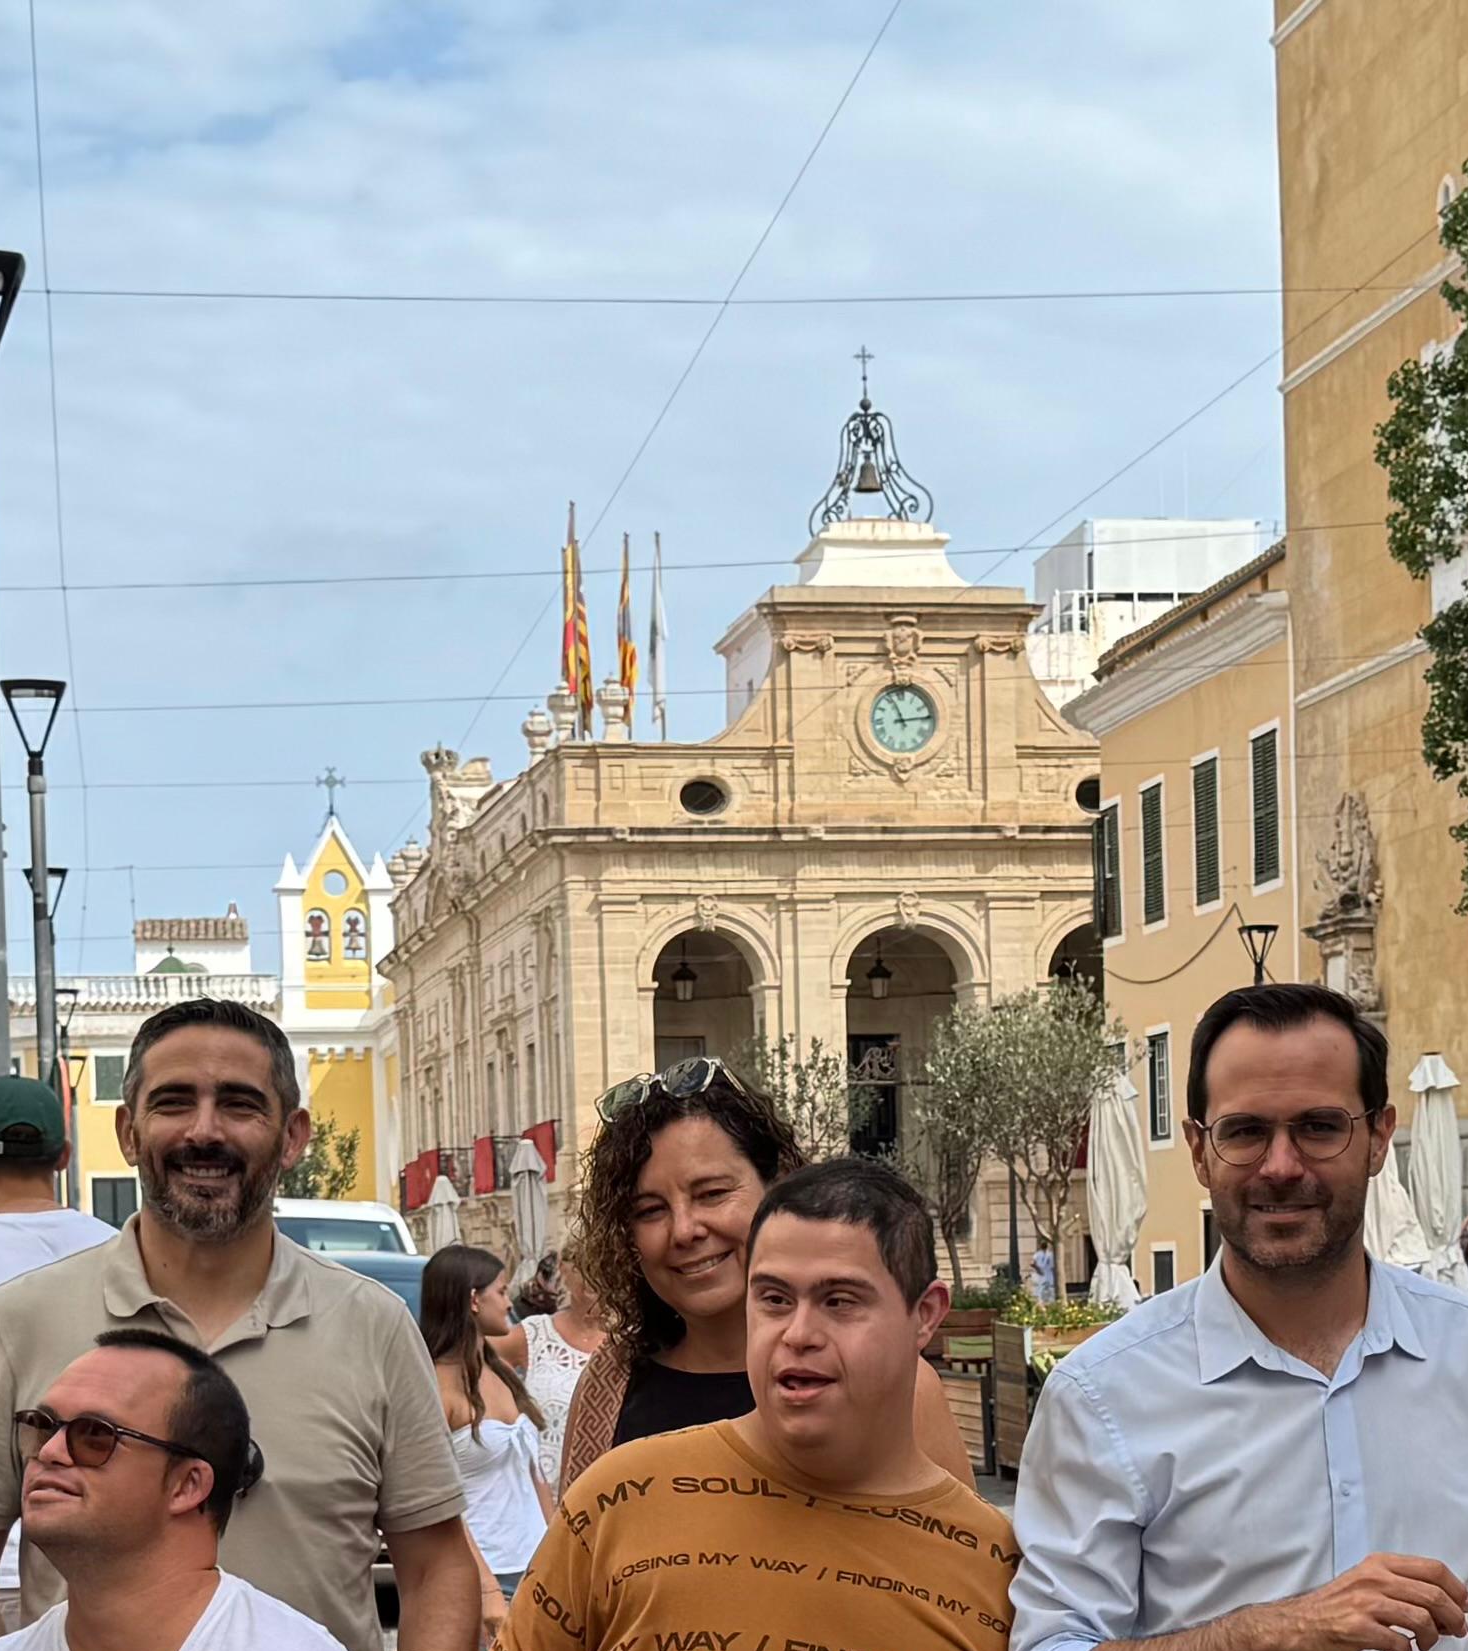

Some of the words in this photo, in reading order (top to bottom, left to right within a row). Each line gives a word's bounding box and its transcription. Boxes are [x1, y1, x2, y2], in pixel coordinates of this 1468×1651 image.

[596, 1476, 655, 1513] MY
[672, 1476, 787, 1499] SOUL
[611, 1552, 691, 1587] LOSING
[698, 1552, 739, 1566] MY
[750, 1555, 808, 1575] WAY
[835, 1570, 930, 1602] FINDING
[937, 1594, 972, 1617] MY
